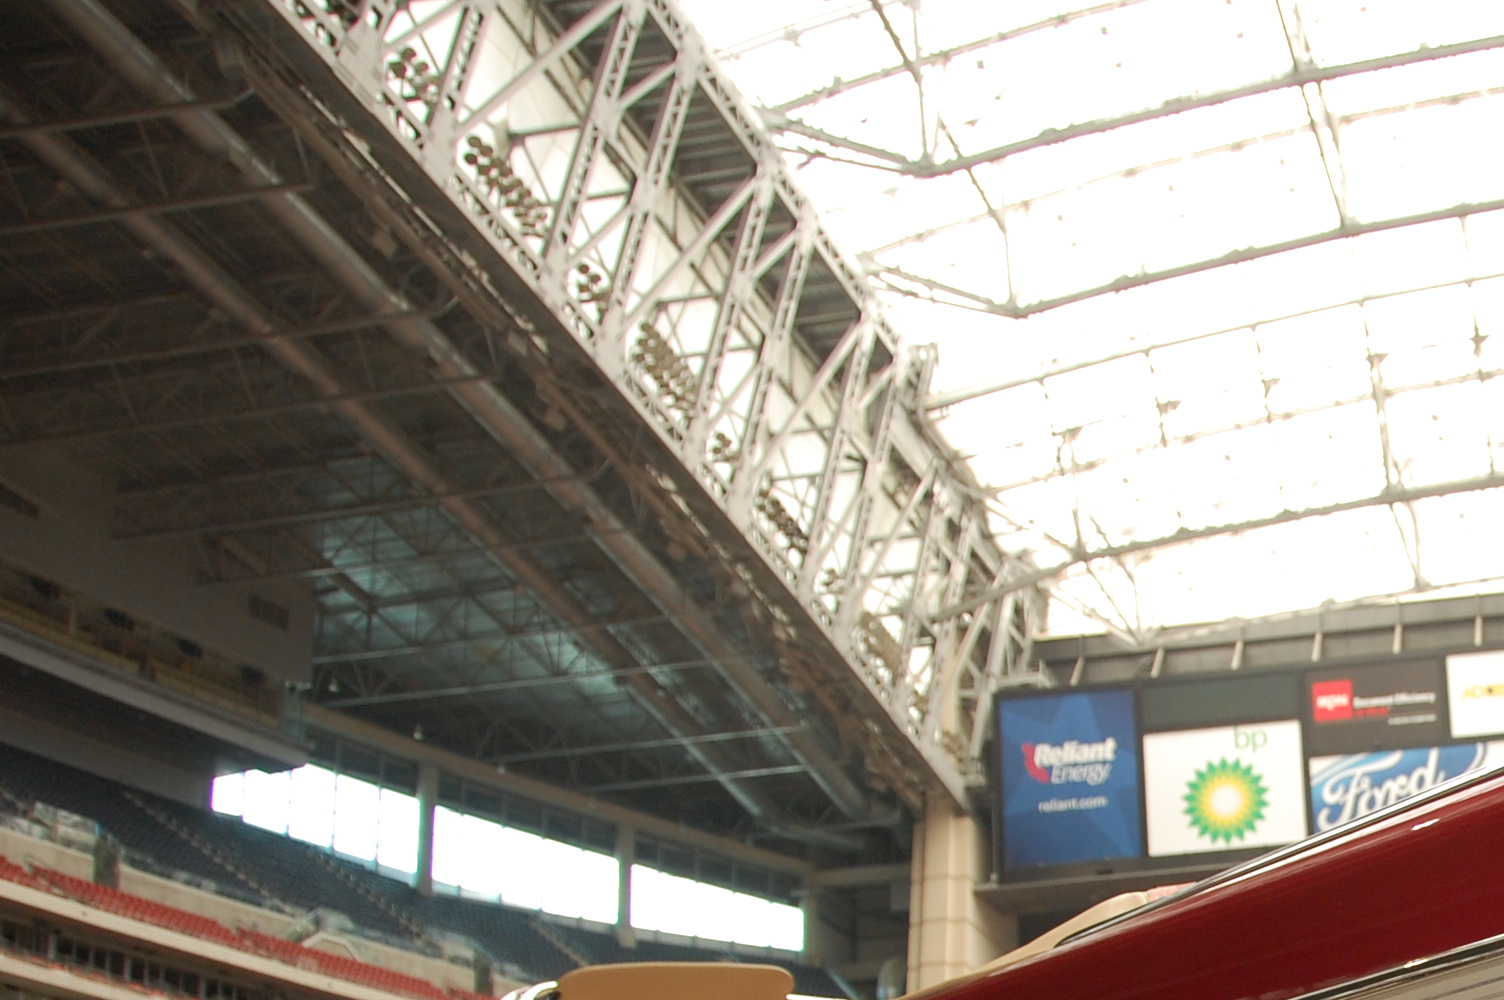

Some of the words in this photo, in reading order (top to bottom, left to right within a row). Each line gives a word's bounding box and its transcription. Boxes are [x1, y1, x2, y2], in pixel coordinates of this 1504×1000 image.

[1033, 736, 1117, 768] Reliant
[1233, 725, 1268, 753] bp
[1050, 763, 1113, 786] Energy
[1317, 748, 1443, 832] Ford
[1038, 795, 1108, 814] reliant.com
